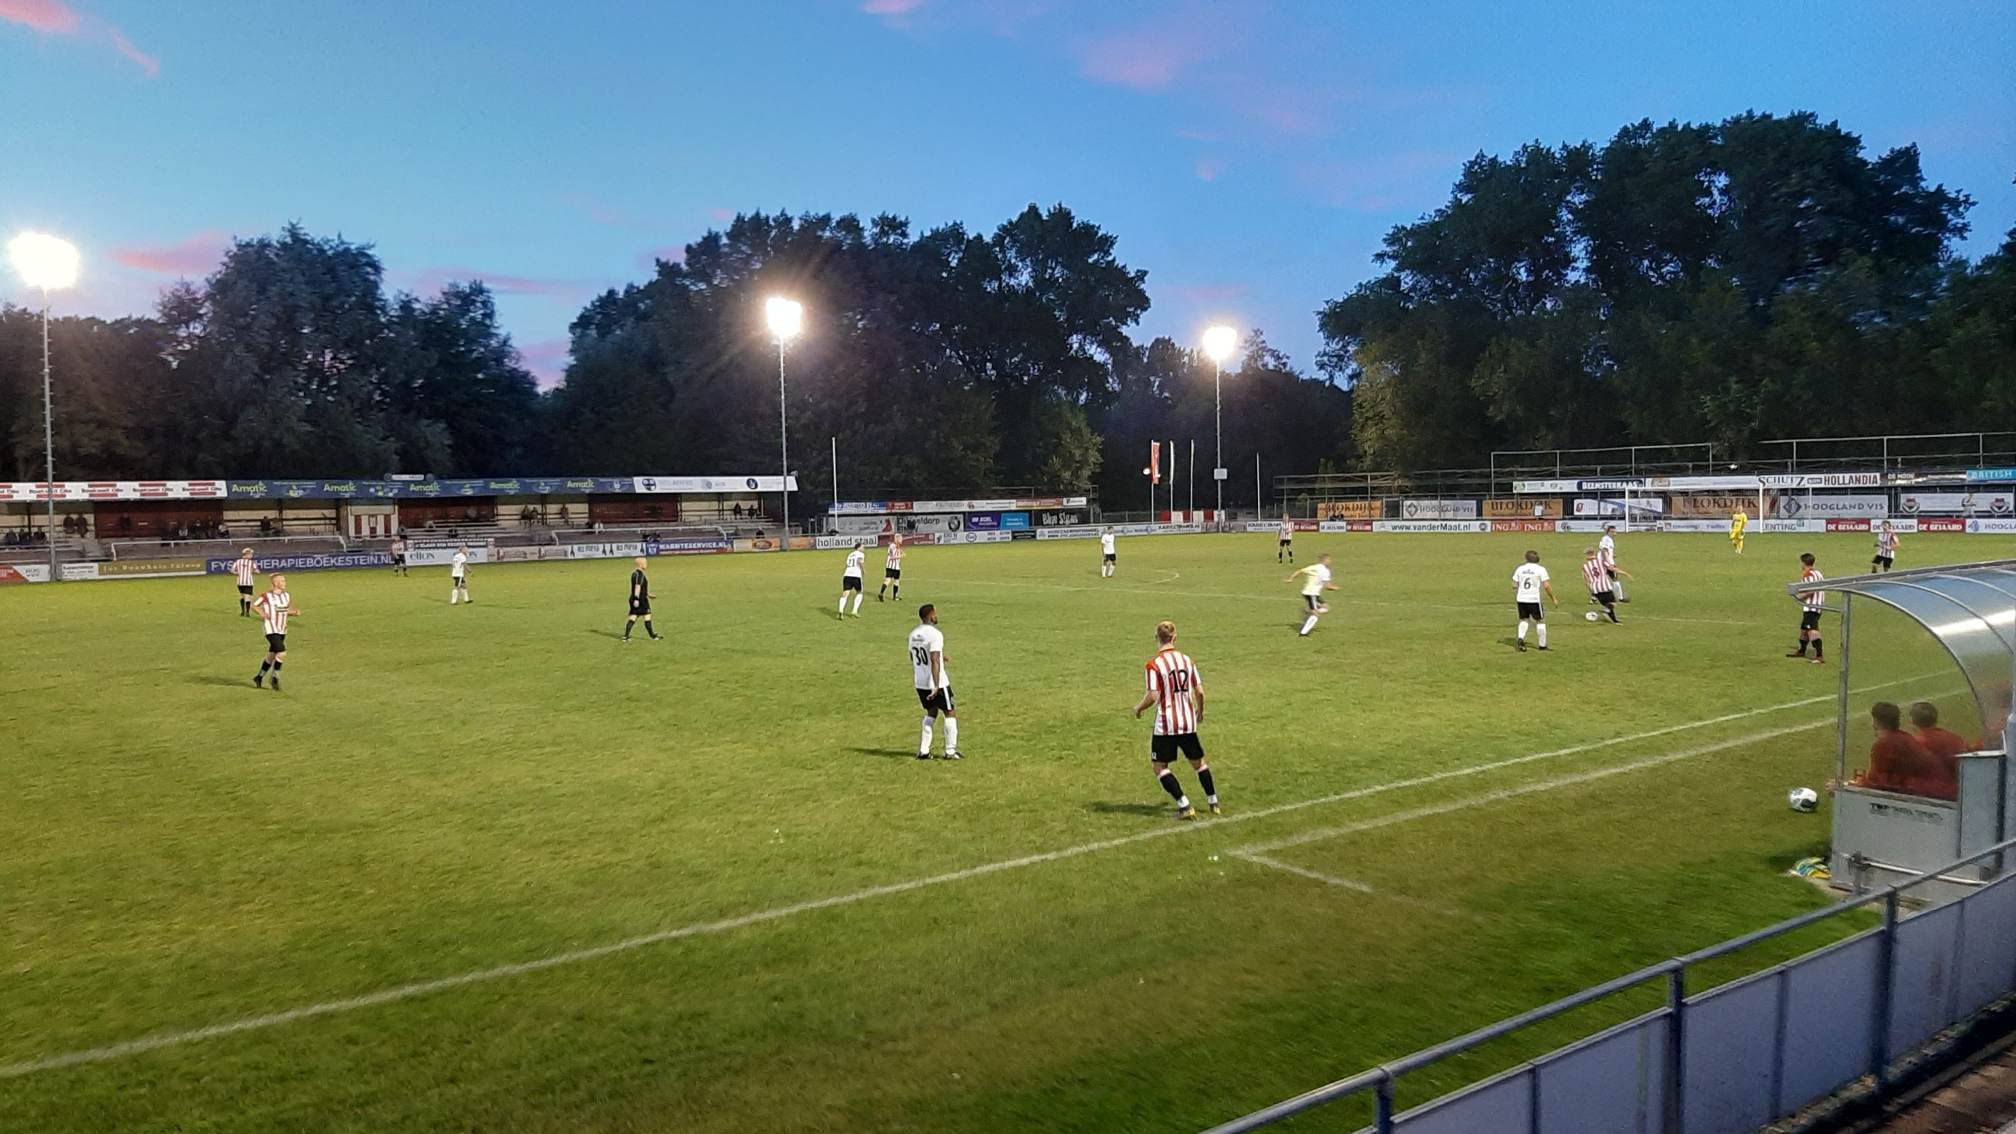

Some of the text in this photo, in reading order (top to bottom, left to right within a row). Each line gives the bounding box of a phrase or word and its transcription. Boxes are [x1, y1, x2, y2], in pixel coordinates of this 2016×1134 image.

[1823, 474, 1878, 485] HOLLANDIA
[1867, 503, 1884, 511] VIS
[1391, 523, 1471, 531] www.vanderMaat.nl
[1492, 523, 1508, 531] ING
[1524, 523, 1541, 531] ING
[817, 536, 877, 548] holland staal
[1523, 577, 1531, 589] 6
[912, 646, 928, 666] 30
[1169, 669, 1189, 692] 12
